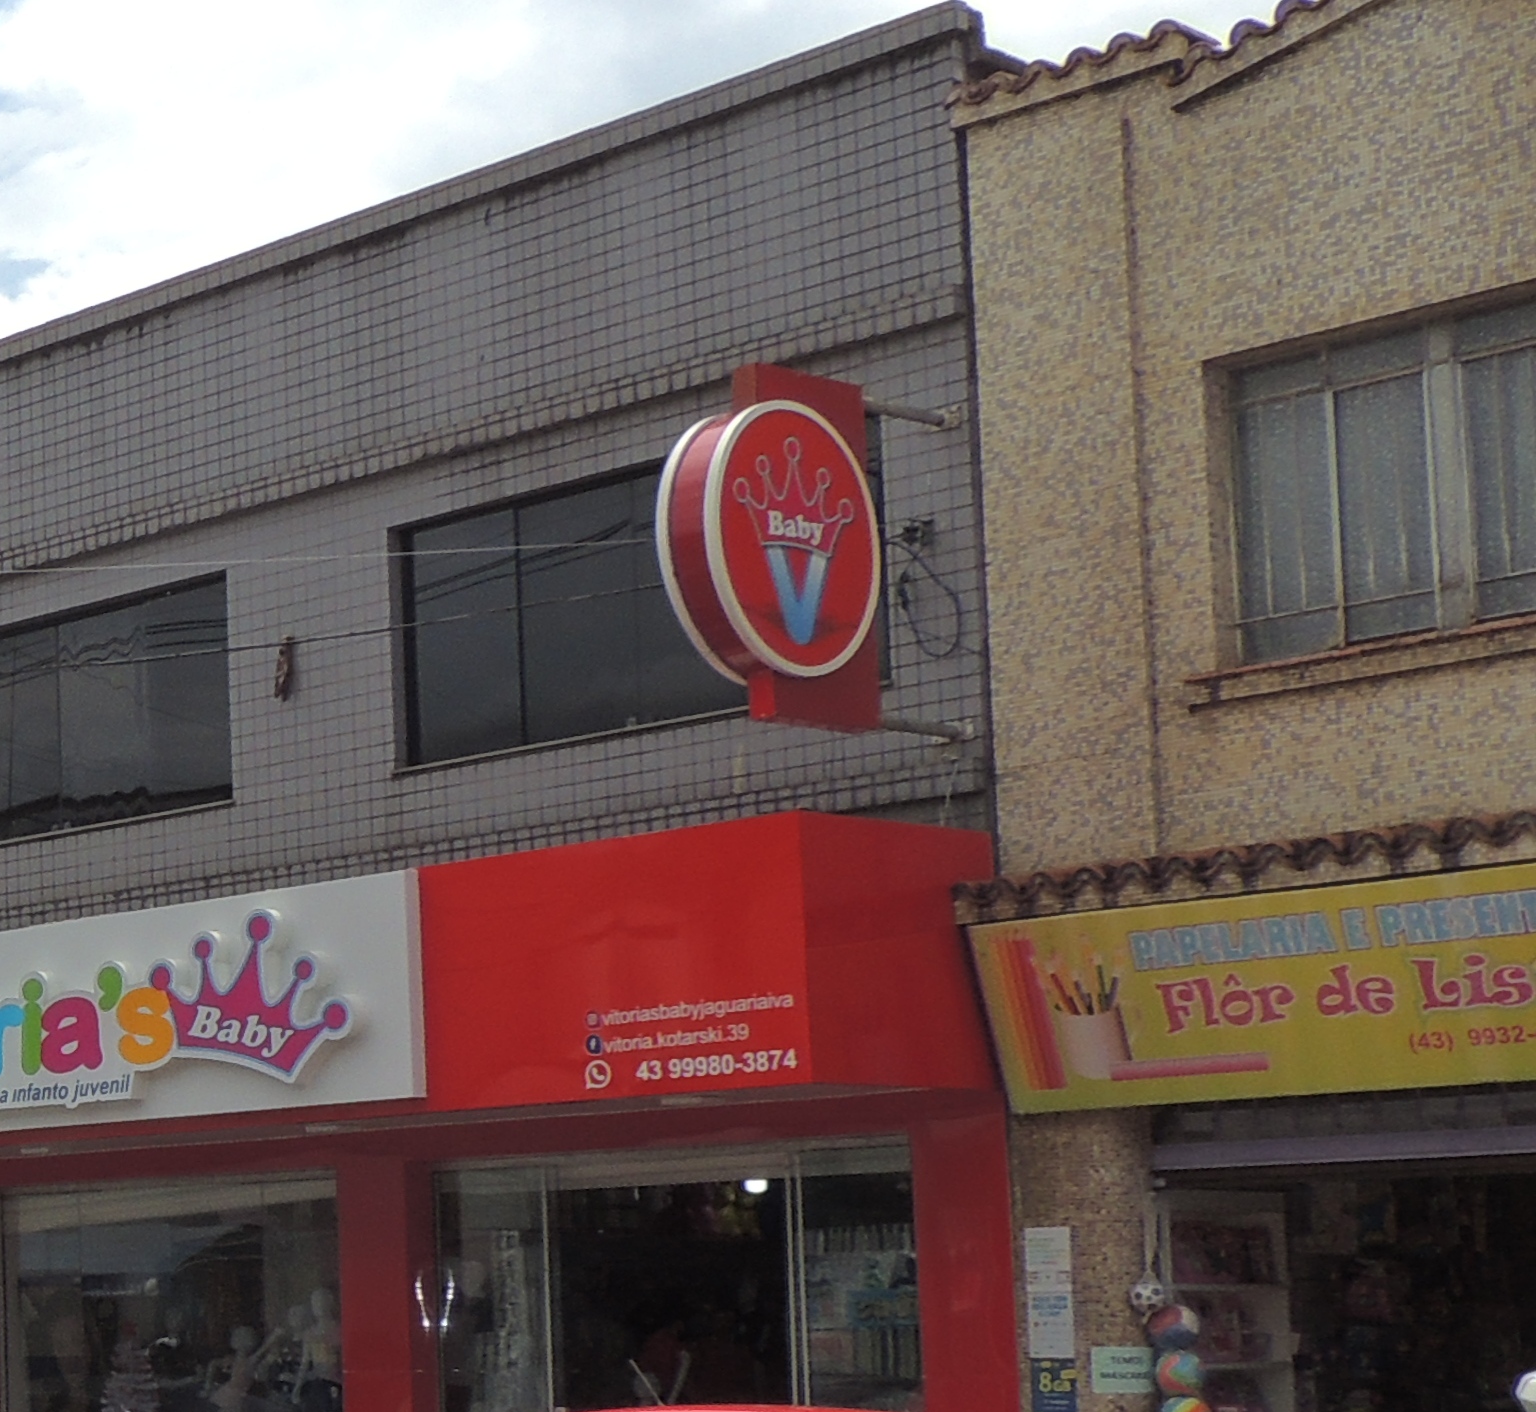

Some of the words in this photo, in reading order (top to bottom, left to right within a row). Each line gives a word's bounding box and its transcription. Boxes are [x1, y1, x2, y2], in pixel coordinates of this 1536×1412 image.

[767, 510, 825, 546] Baby
[765, 545, 829, 646] V
[1128, 911, 1340, 972] PAPELARIA
[1340, 907, 1372, 952] E
[602, 992, 794, 1027] vitoriasbabyjaguariaiva
[1155, 972, 1296, 1035] Flôr
[1315, 963, 1396, 1018] de
[1408, 953, 1534, 1012] Lis
[188, 1003, 295, 1058] Baby
[603, 1023, 750, 1054] vitoria.kotarski.39
[1408, 1030, 1454, 1053] (43)
[635, 1060, 663, 1081] 43
[668, 1048, 798, 1080] 99980-3874
[12, 1083, 69, 1103] infanto
[72, 1074, 131, 1103] juvenil
